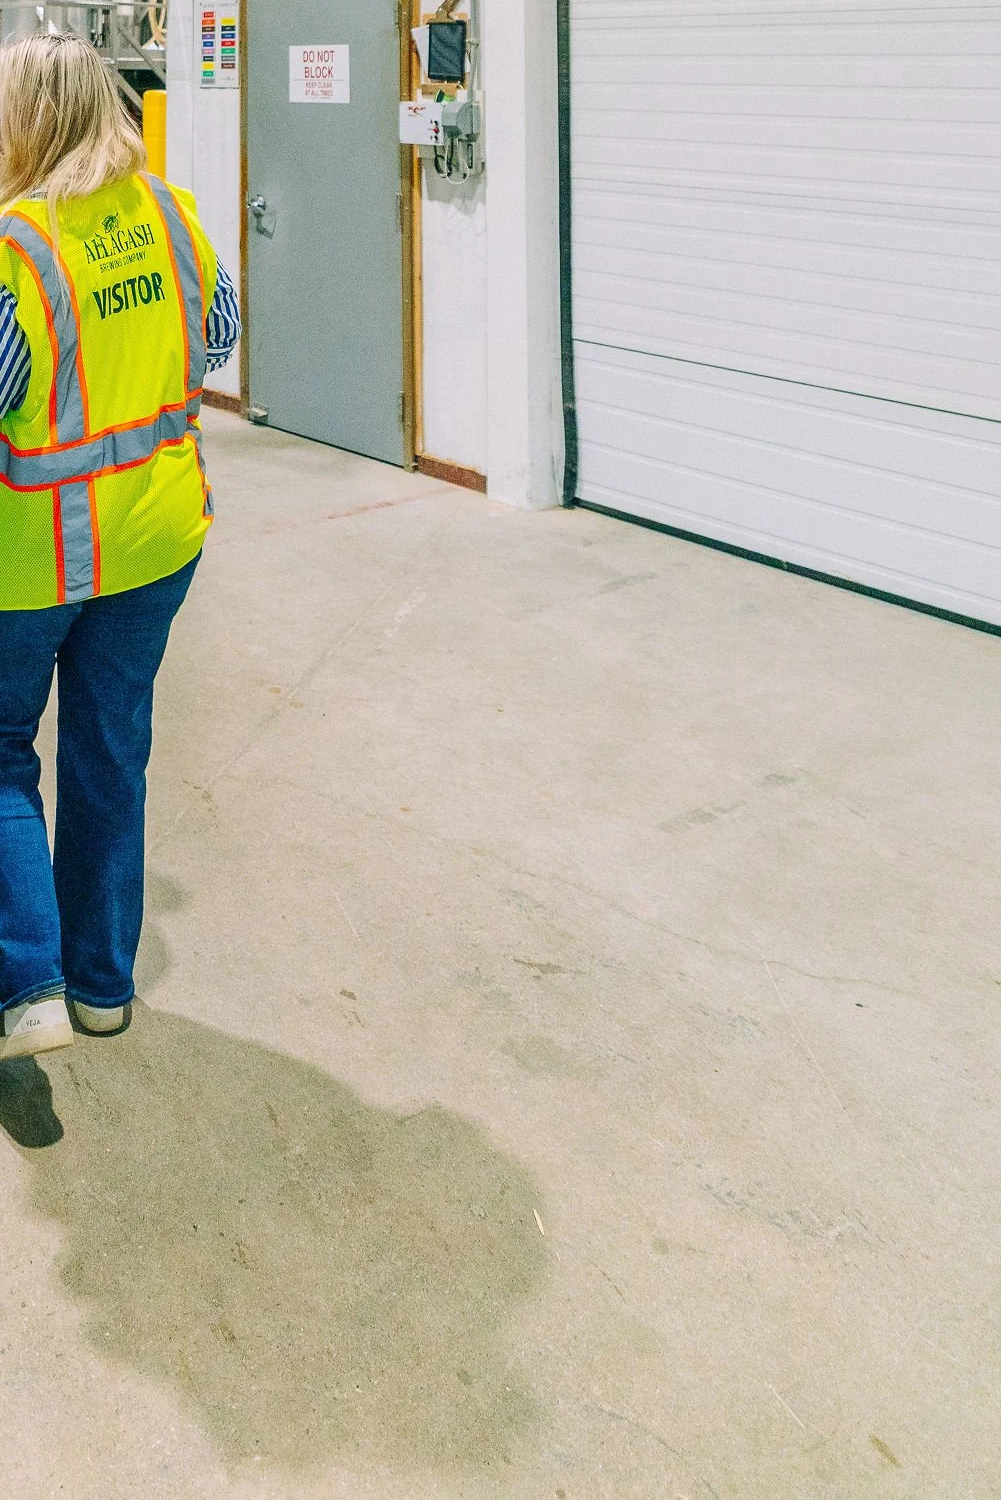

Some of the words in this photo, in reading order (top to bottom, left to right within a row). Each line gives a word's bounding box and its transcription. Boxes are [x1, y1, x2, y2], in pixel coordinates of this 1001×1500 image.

[303, 50, 315, 62] DO
[318, 50, 336, 62] NOT
[304, 66, 334, 78] BLOCK
[84, 223, 155, 264] ALLAGASH
[100, 258, 122, 273] BREWING
[123, 251, 146, 266] COMPANY
[92, 272, 166, 320] VISITOR
